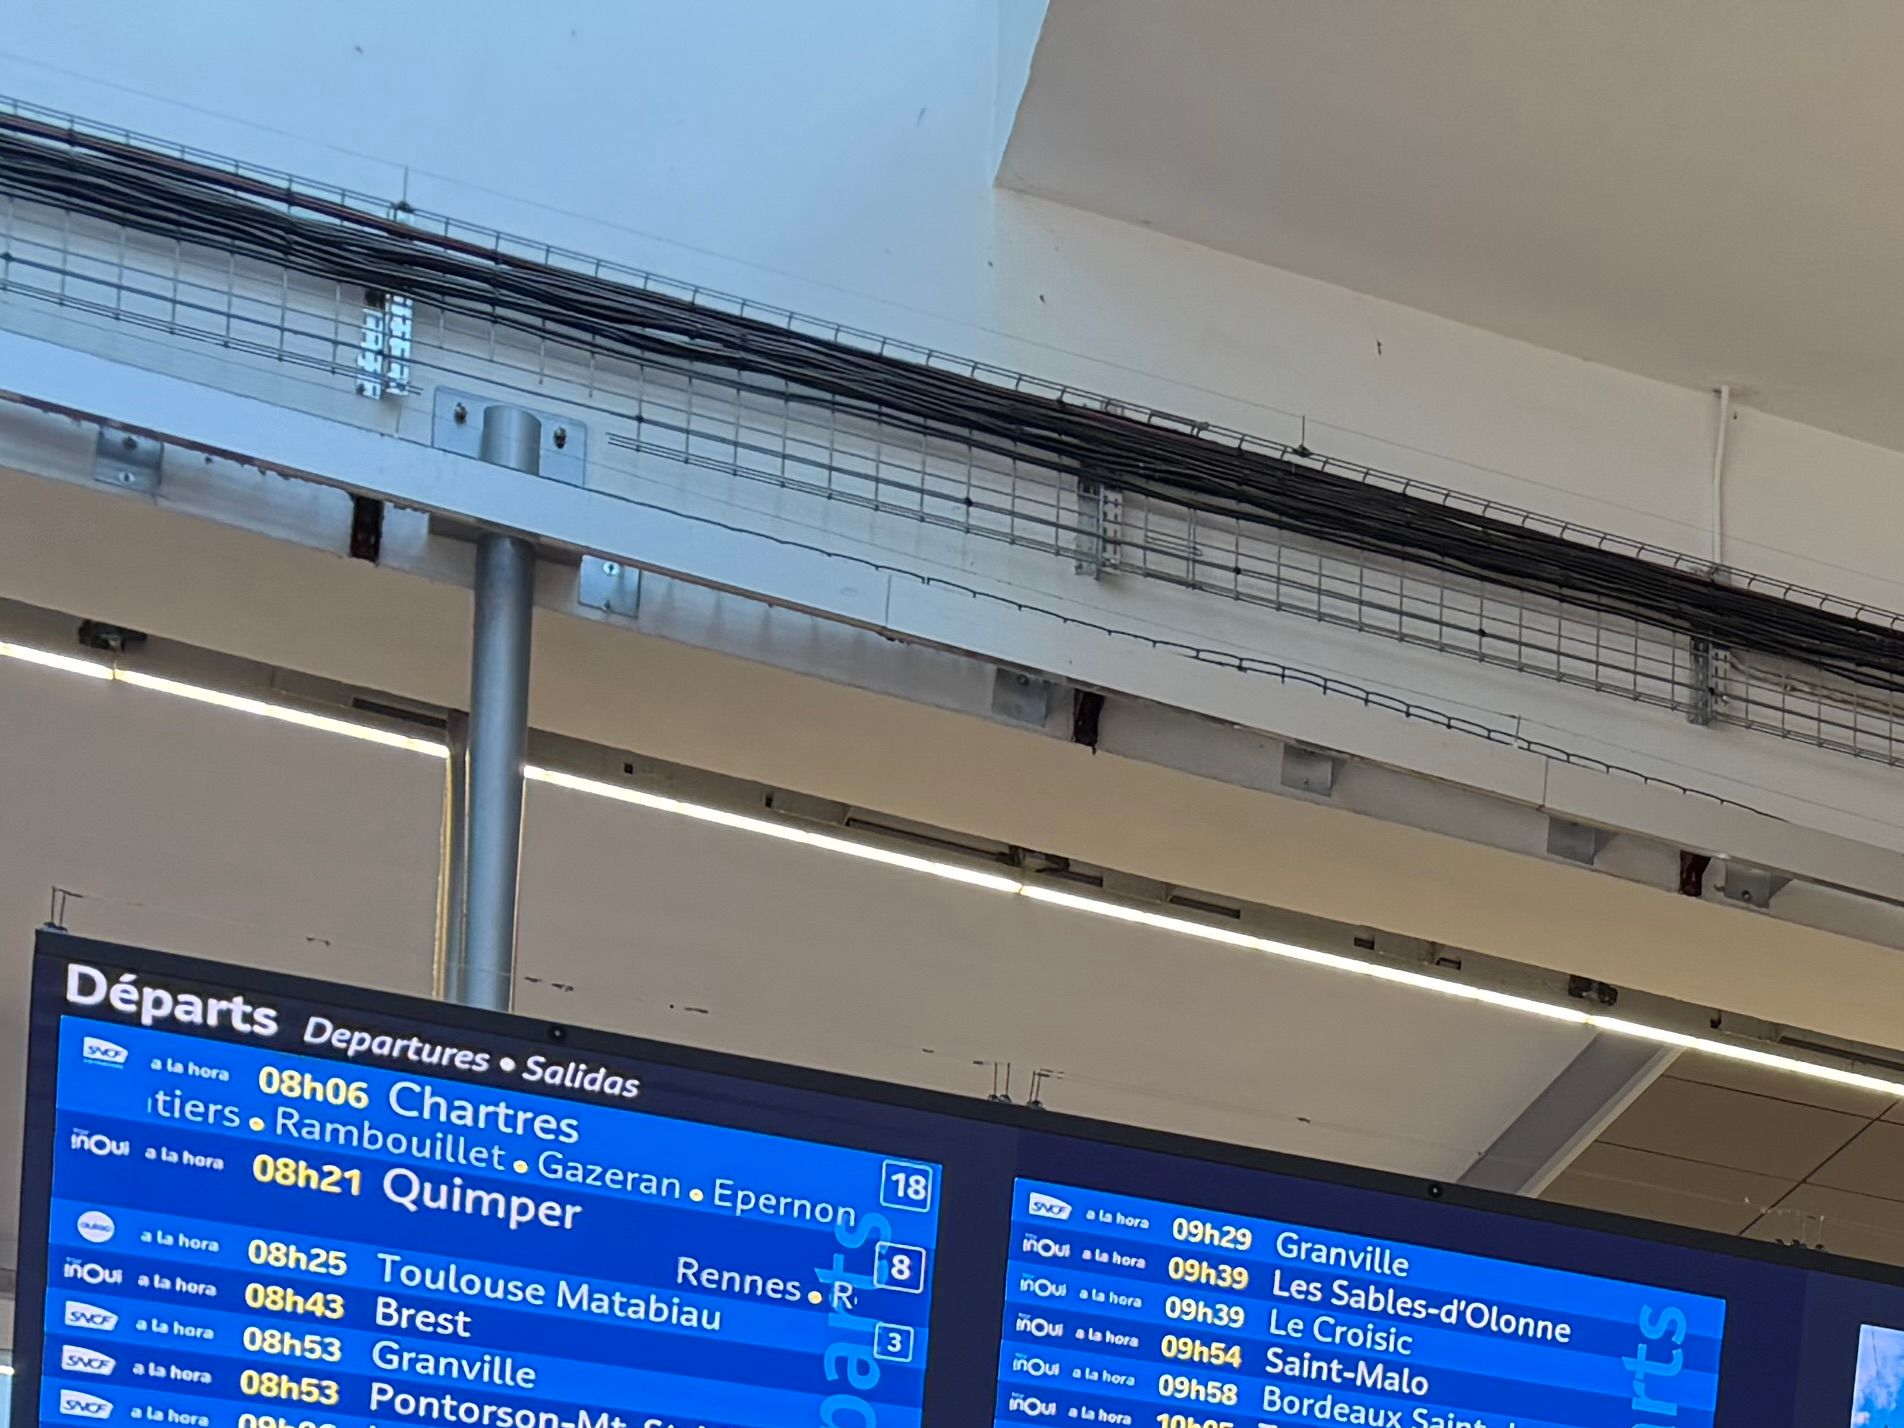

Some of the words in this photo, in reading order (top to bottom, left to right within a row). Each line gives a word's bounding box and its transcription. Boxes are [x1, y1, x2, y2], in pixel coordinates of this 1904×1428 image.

[65, 963, 279, 1037] Départs
[303, 1015, 490, 1074] Departures
[521, 1055, 641, 1099] Salidas
[258, 1066, 370, 1110] 08h06
[388, 1080, 580, 1145] Chartres
[147, 1090, 241, 1129] tiers
[276, 1106, 505, 1172] Rambouillet
[537, 1150, 681, 1200] Gazeran
[712, 1178, 856, 1228] Epernon
[890, 1172, 927, 1201] 18
[252, 1153, 362, 1197] 08h21
[382, 1167, 583, 1231] Quimper
[676, 1256, 802, 1300] Rennes
[890, 1253, 911, 1280] 8
[1172, 1217, 1253, 1251] 09h29
[1276, 1232, 1410, 1278] Granville
[243, 1282, 345, 1321] 08h43
[375, 1296, 472, 1338] Brest
[247, 1238, 348, 1278] 08h25
[376, 1251, 546, 1307] Toulouse
[556, 1280, 722, 1332] Matabiau
[1167, 1256, 1250, 1291] 09h39
[1272, 1268, 1323, 1304] Les
[1330, 1278, 1573, 1345] Sables-d'Olonne
[886, 1333, 903, 1354] 3
[1164, 1296, 1246, 1329] 09h39
[1269, 1308, 1304, 1338] Le
[1312, 1315, 1414, 1357] Croisic
[239, 1369, 340, 1407] 08h53
[242, 1326, 343, 1364] 08h53
[371, 1340, 538, 1390] Granville
[1160, 1334, 1243, 1369] 09h54
[1265, 1346, 1430, 1397] Saint-Malo
[1157, 1373, 1239, 1407] 09h58
